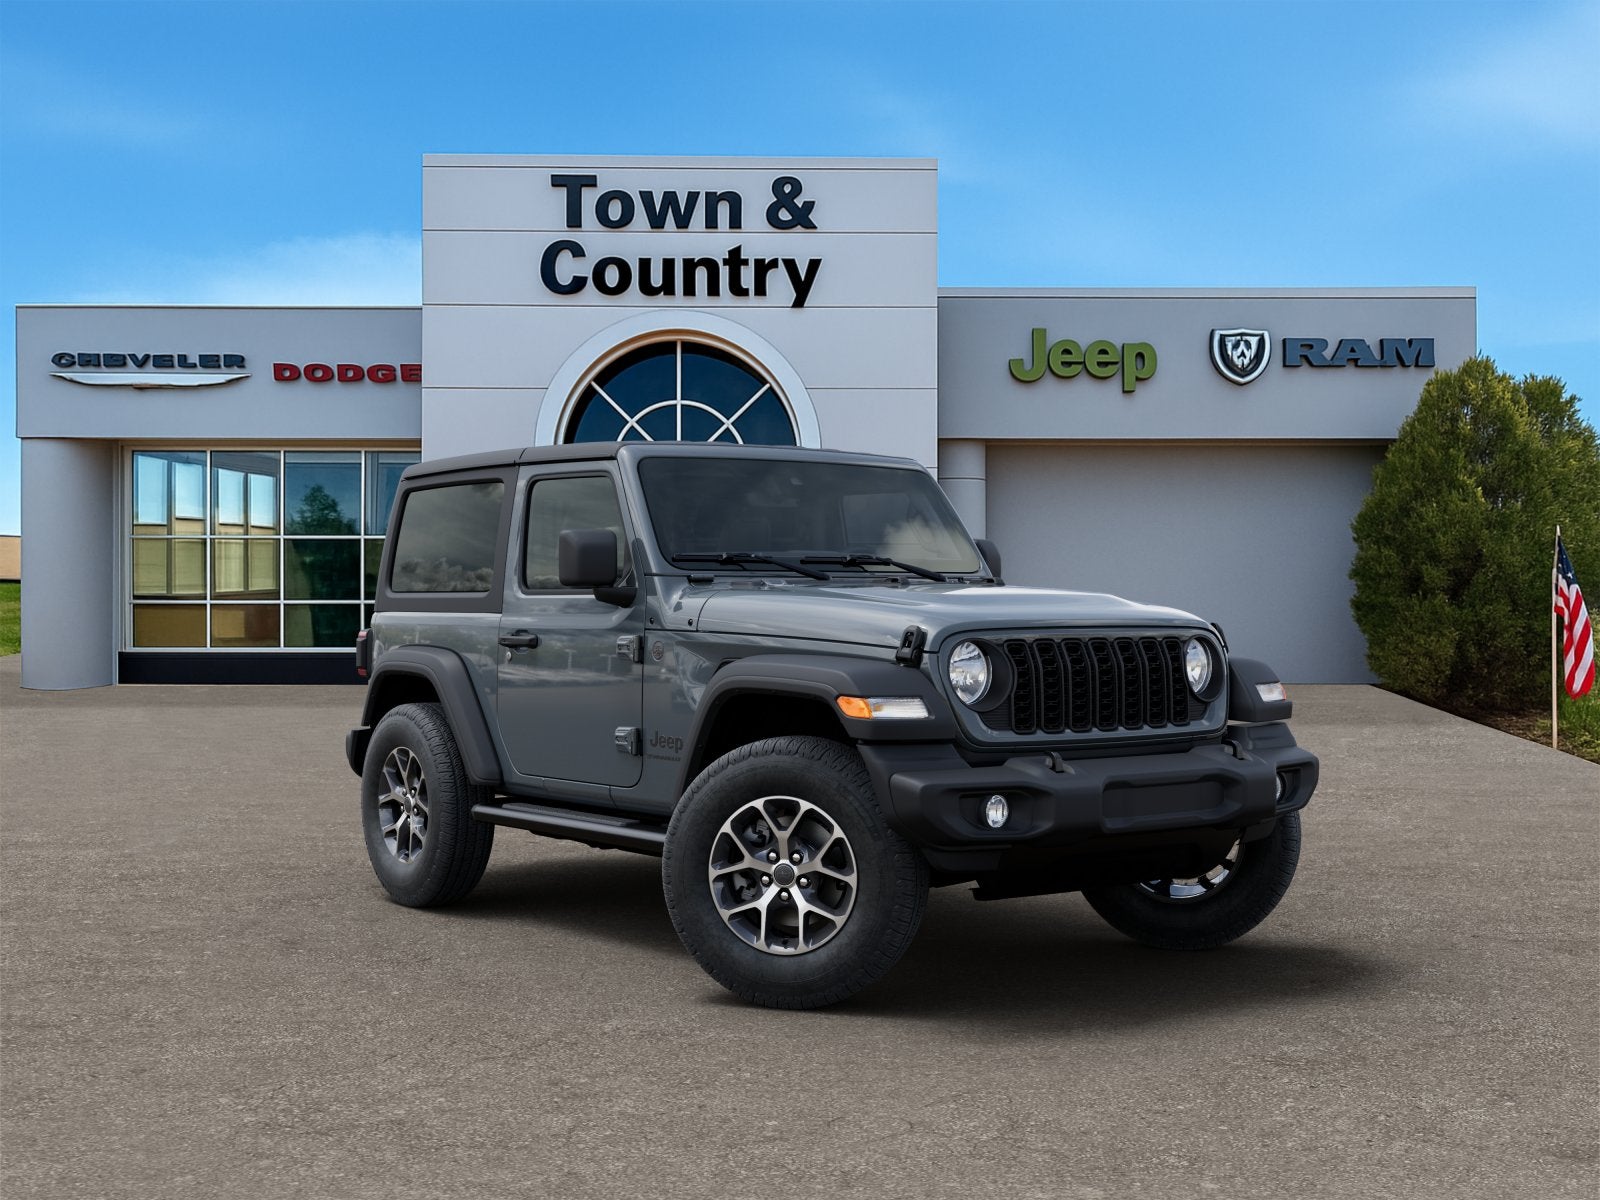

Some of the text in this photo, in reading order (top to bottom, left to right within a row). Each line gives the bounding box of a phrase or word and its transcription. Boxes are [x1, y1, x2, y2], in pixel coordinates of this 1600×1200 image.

[550, 174, 818, 229] Town &
[540, 239, 822, 308] Country
[273, 362, 422, 383] DODGE
[1009, 327, 1157, 393] Jeep
[1282, 337, 1435, 368] RAM
[649, 729, 684, 754] Jeep
